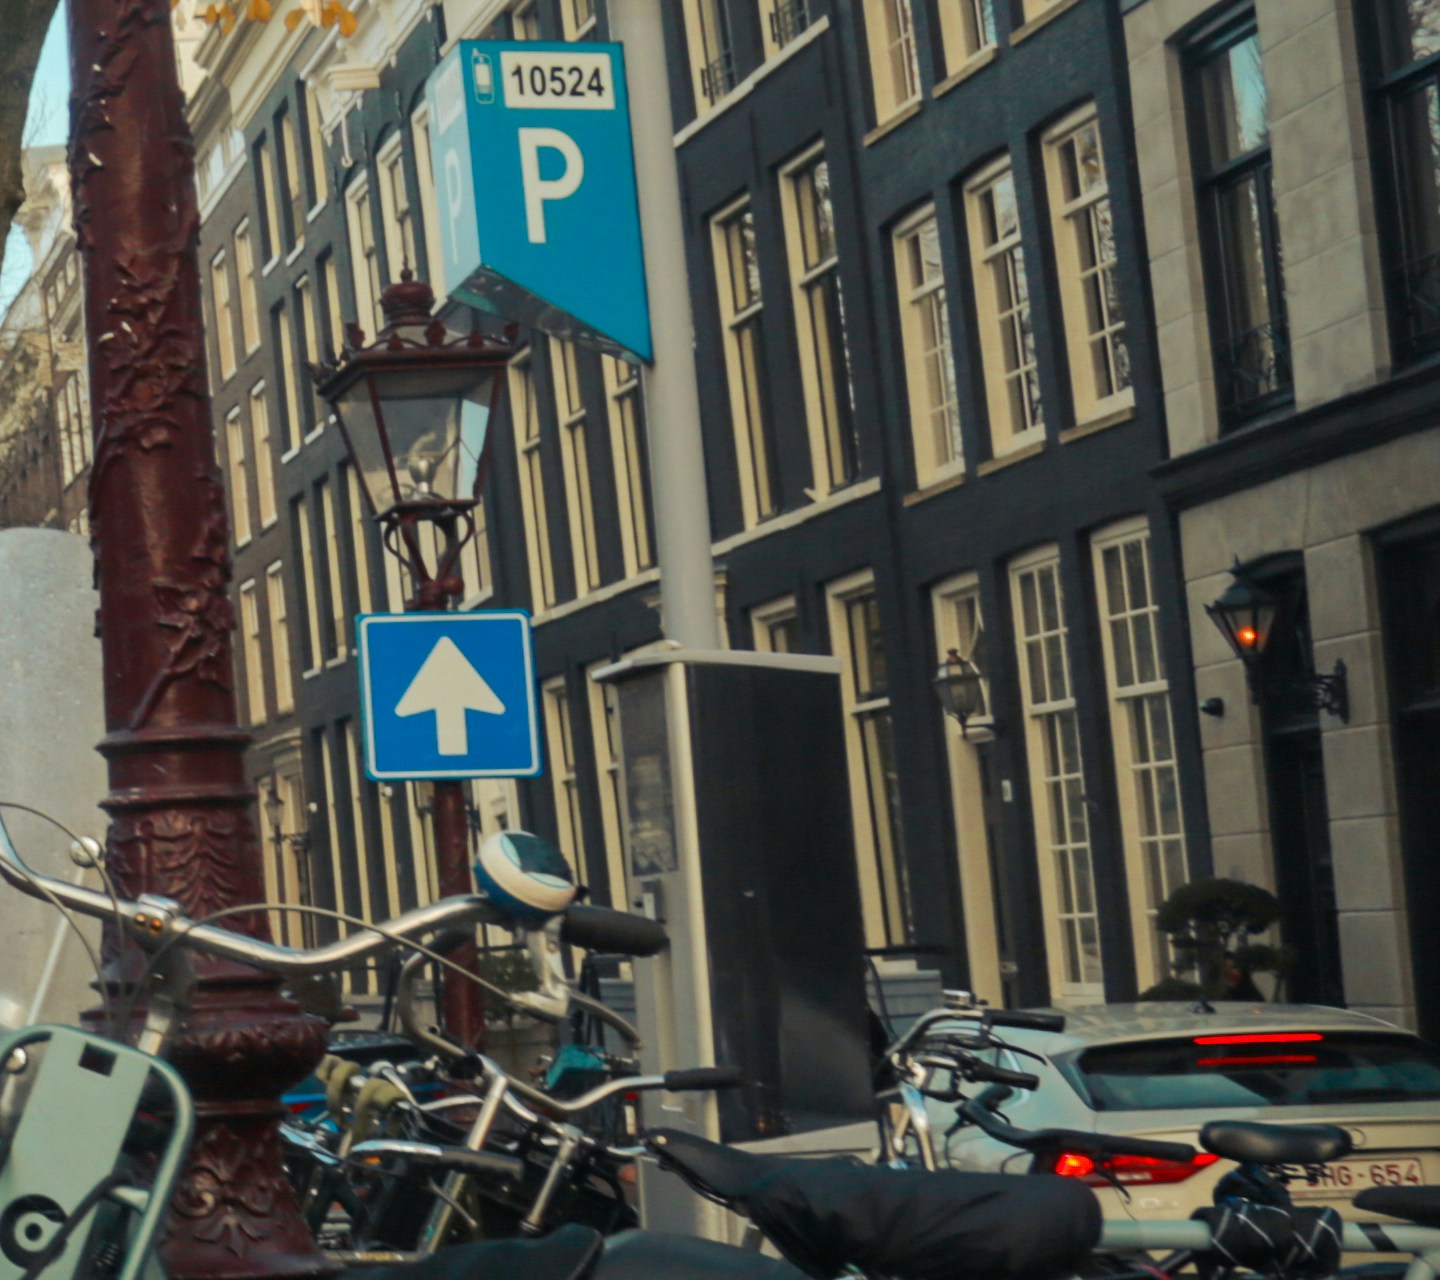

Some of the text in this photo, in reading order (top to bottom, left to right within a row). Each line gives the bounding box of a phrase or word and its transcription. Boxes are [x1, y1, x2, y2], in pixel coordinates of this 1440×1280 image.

[511, 65, 605, 97] 10524
[444, 148, 462, 266] P
[518, 127, 585, 244] P
